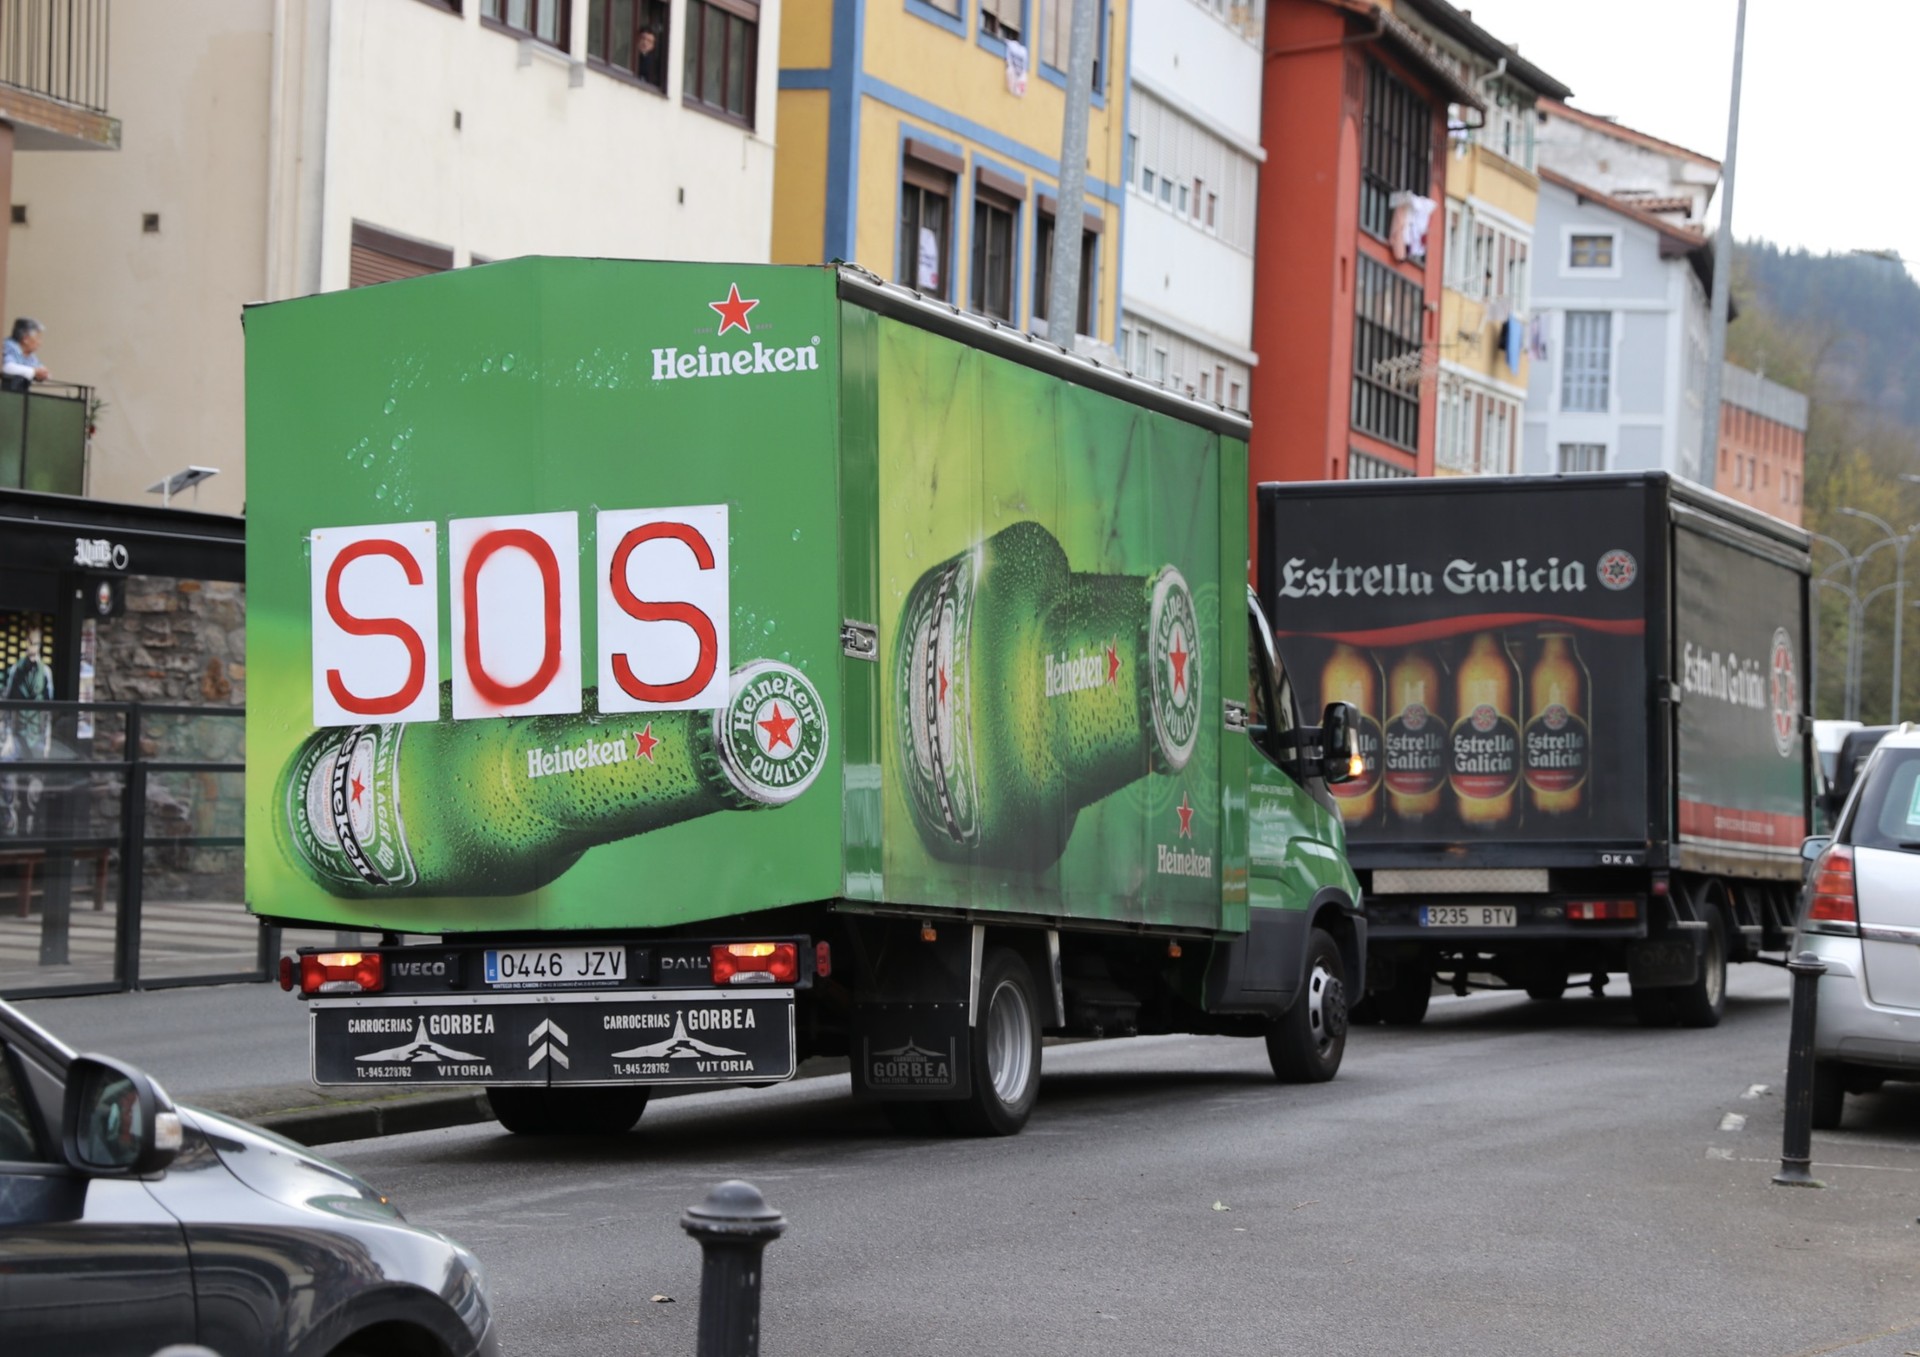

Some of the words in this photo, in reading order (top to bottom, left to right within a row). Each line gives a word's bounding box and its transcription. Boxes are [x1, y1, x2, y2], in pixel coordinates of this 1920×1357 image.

[1278, 557, 1434, 598] Estrella
[1443, 557, 1586, 595] Galicia
[325, 521, 718, 716] SOS
[1045, 648, 1103, 697] Heineken
[1386, 733, 1443, 751] Estrella
[1454, 735, 1514, 753] Estrella
[1527, 732, 1583, 749] Estrella
[527, 738, 628, 779] Heineken
[751, 745, 816, 784] QUALITY
[1387, 751, 1440, 769] Galicia
[1455, 753, 1513, 773] Galicia
[1528, 749, 1582, 768] Galicia
[376, 781, 392, 843] LAGER
[1157, 844, 1212, 878] Heineken
[1601, 853, 1634, 865] OKA
[1428, 908, 1469, 924] 3235
[1483, 908, 1514, 924] BTV
[391, 961, 446, 976] IVECO
[501, 952, 563, 977] 0446
[577, 951, 622, 976] JZV
[348, 1018, 413, 1034] CARROCERIAS
[430, 1014, 495, 1035] GORBEA
[603, 1014, 670, 1030] CARROCERIAS
[688, 1008, 756, 1030] GORBEA
[437, 1064, 493, 1077] VITORIA
[696, 1060, 754, 1072] VITORIA
[873, 1062, 948, 1077] GORBEA
